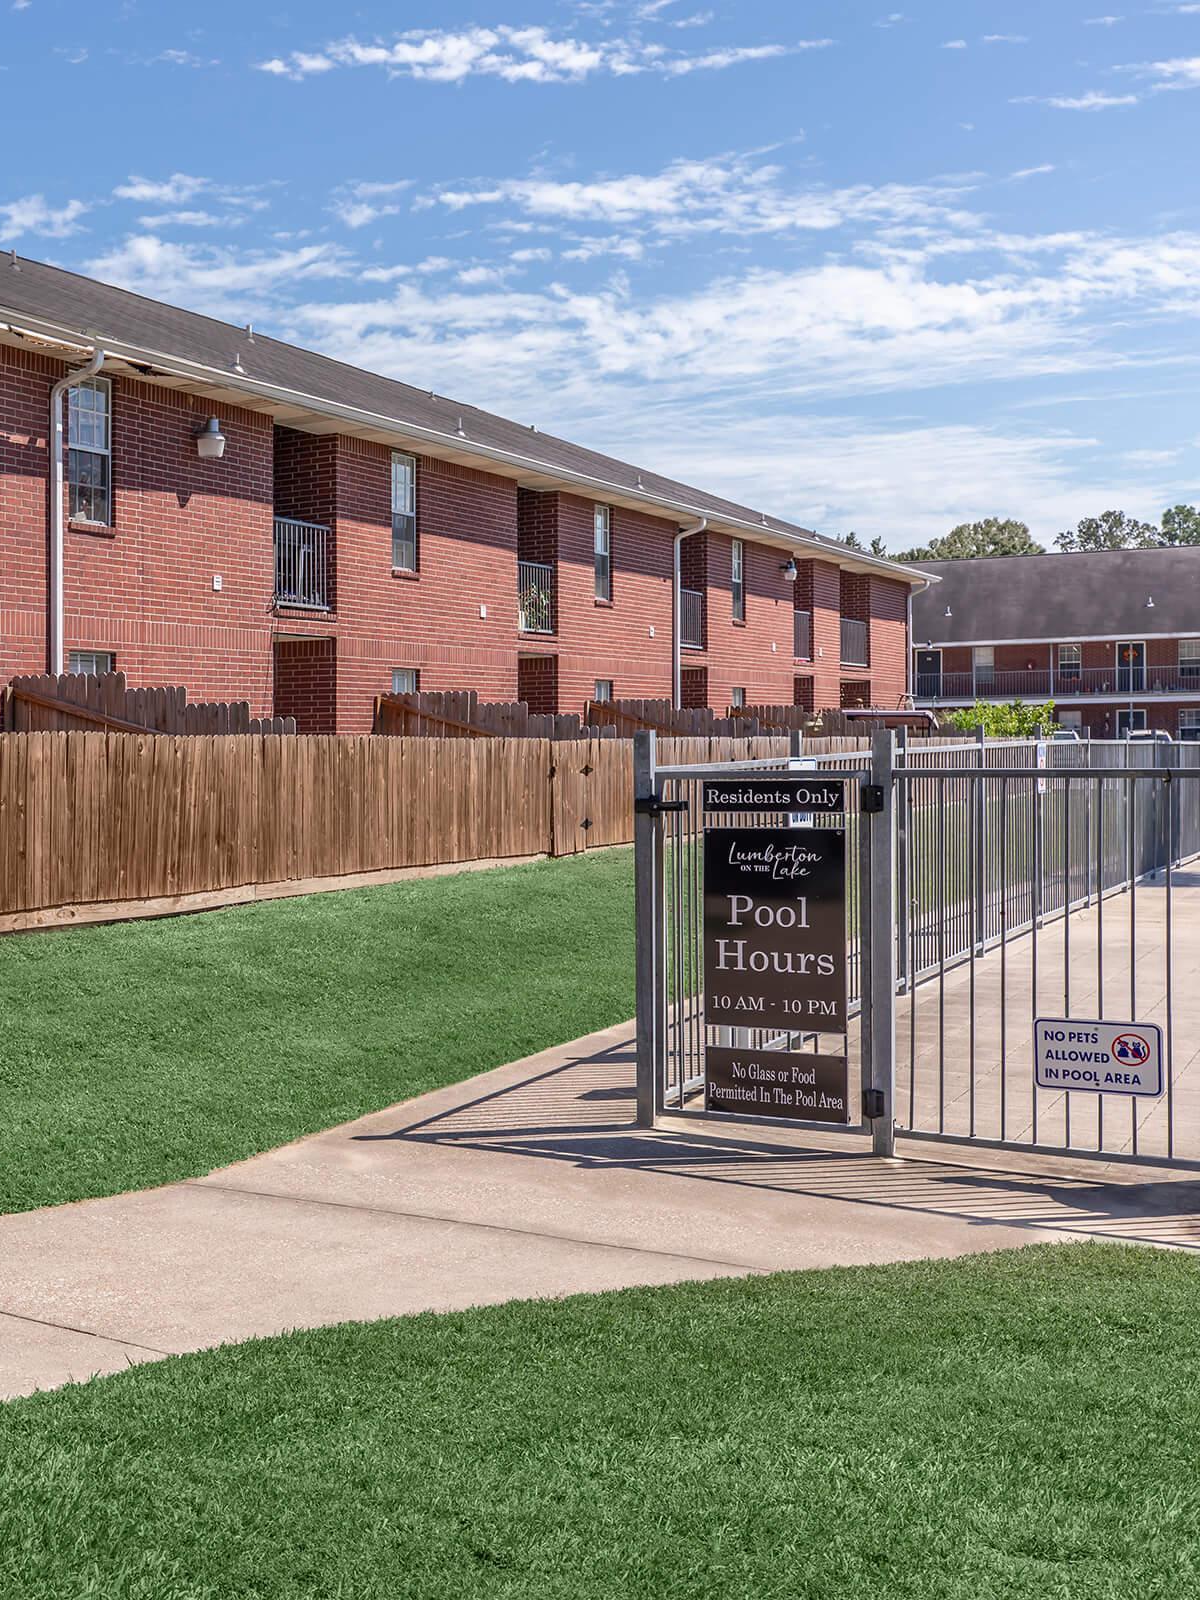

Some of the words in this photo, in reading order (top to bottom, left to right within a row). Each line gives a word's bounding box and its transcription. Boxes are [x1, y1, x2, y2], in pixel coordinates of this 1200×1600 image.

[706, 789, 791, 804] Residents
[796, 788, 839, 806] Only
[728, 842, 822, 864] Lumberton
[772, 860, 811, 880] Lake
[726, 894, 810, 928] Pool
[715, 939, 835, 976] Hours
[712, 995, 731, 1009] 10
[734, 996, 766, 1011] AM
[783, 1000, 801, 1014] 10
[807, 1000, 837, 1016] PM
[1044, 1030, 1066, 1042] NO
[1069, 1032, 1098, 1044] PETS
[1045, 1049, 1110, 1063] ALLOWED
[732, 1062, 746, 1079] No
[748, 1063, 775, 1081] Glass
[778, 1071, 789, 1082] or
[791, 1066, 816, 1085] Food
[1045, 1068, 1058, 1079] IN
[1062, 1069, 1100, 1082] POOL
[1104, 1072, 1141, 1085] AREA
[709, 1082, 757, 1101] Permitted
[760, 1086, 770, 1103] In
[773, 1087, 792, 1105] The
[795, 1089, 817, 1108] Pool
[818, 1092, 843, 1110] Area
